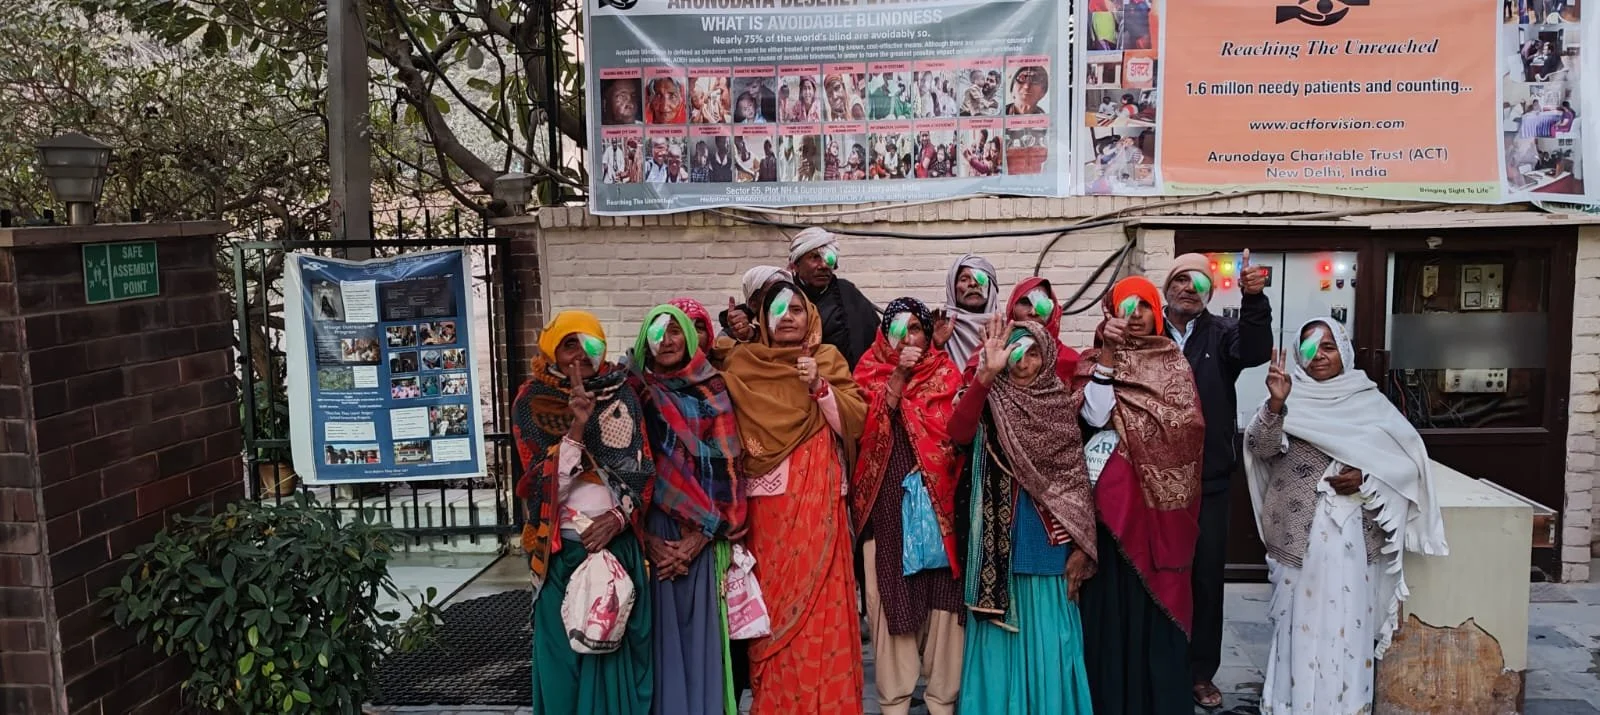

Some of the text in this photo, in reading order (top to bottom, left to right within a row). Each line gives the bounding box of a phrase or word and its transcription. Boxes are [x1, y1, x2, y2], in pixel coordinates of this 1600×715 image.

[701, 9, 942, 31] WHAT IS AVOIDABLE BLINDNESS
[713, 34, 742, 45] Nearly
[744, 34, 764, 43] 75%
[765, 33, 776, 42] of
[777, 33, 793, 42] the
[794, 31, 826, 42] world's
[829, 31, 852, 40] blind
[871, 30, 915, 39] avoidably
[917, 30, 930, 38] so.
[1219, 37, 1439, 58] Reaching The Unreached
[1185, 78, 1473, 99] 1.6 millon needy patients and counting...
[1249, 117, 1405, 132] www.actforvision.com
[1207, 147, 1448, 164] Arunodaya Charitable Trust (ACT)
[1266, 165, 1388, 180] New Delhi, India
[726, 186, 751, 194] Sector
[764, 186, 779, 194] Plot
[780, 185, 791, 193] NH
[1419, 187, 1447, 195] Bringing
[122, 246, 144, 259] SAFE
[113, 262, 155, 278] ASSEMBLY
[123, 280, 148, 295] POINT
